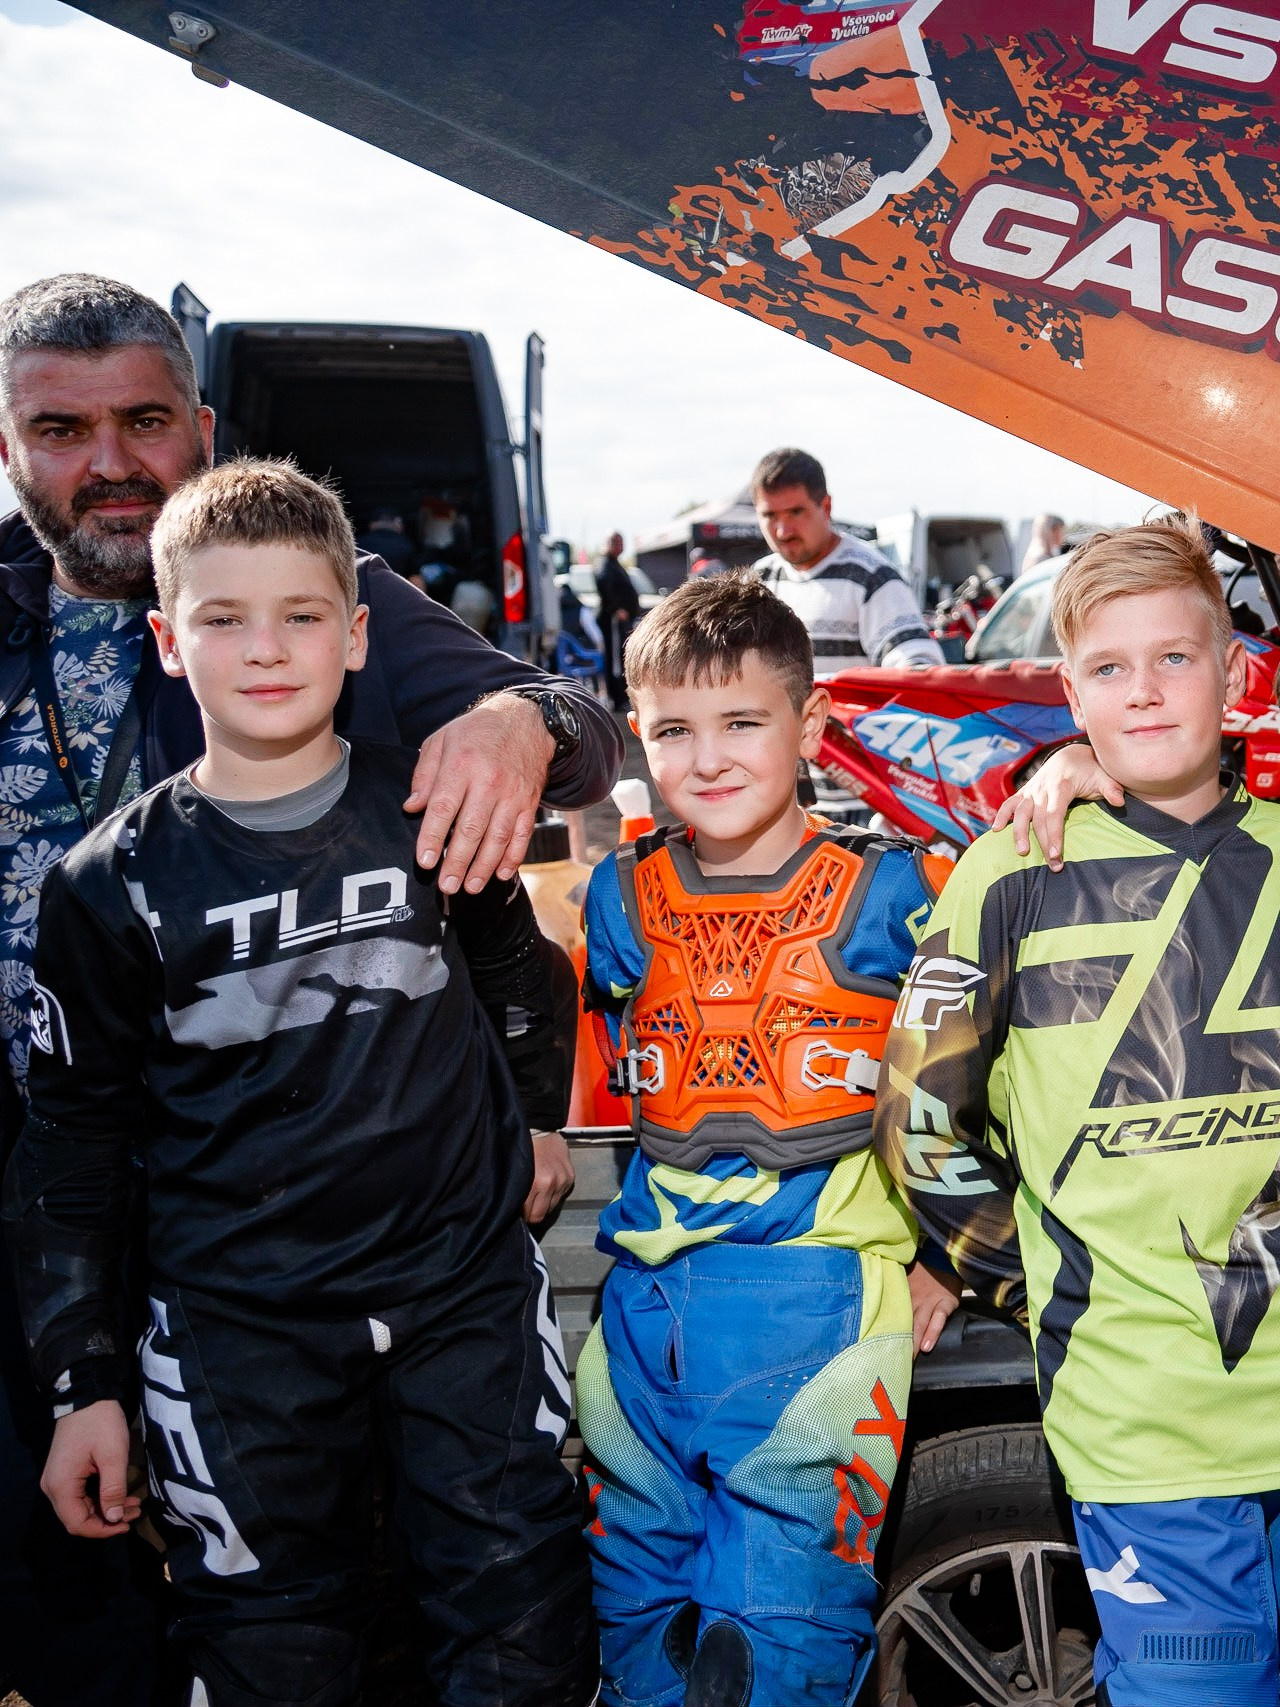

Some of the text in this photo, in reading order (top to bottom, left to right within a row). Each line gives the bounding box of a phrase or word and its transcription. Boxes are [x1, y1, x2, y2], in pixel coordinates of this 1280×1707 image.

[46, 703, 64, 755] MOTOROLA
[853, 712, 996, 786] 404
[205, 866, 407, 961] TLD
